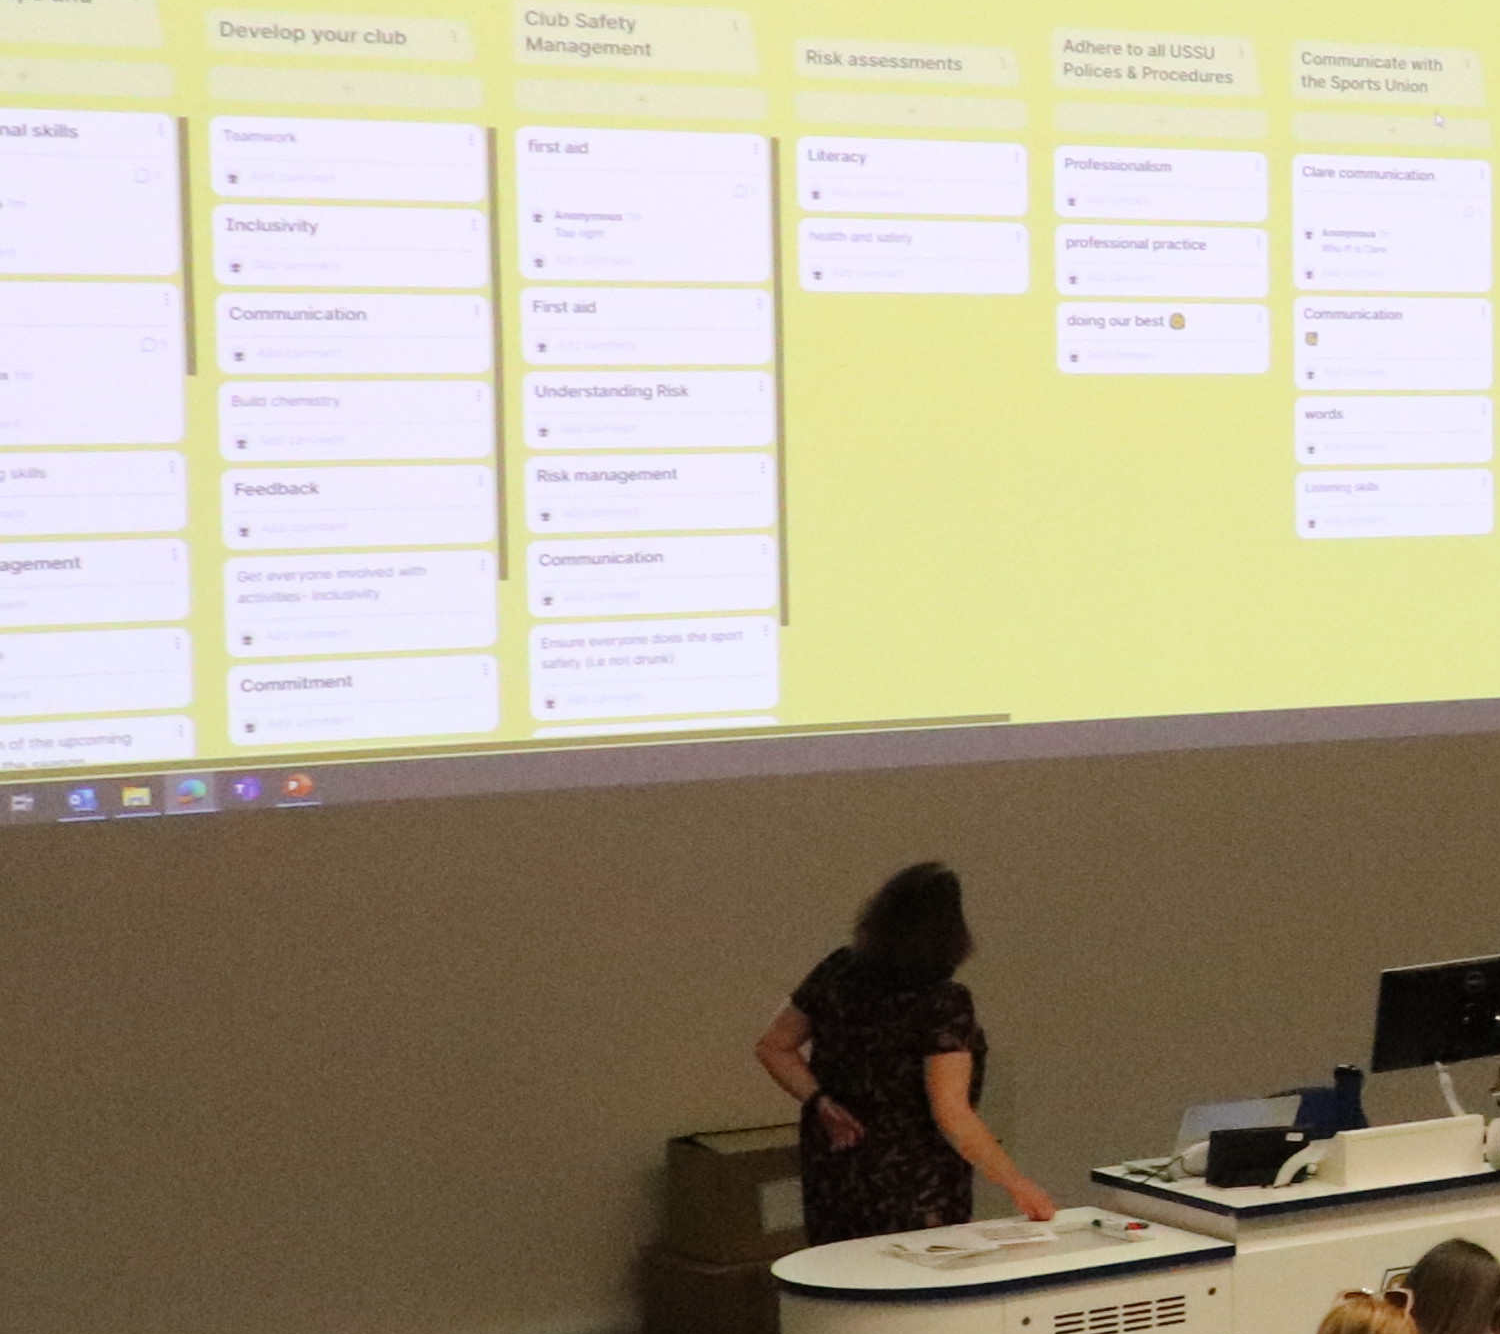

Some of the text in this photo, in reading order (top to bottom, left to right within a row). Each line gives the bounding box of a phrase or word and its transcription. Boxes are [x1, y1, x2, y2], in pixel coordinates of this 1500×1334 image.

[524, 10, 636, 34] Club Safety
[219, 20, 407, 46] Develop your club
[526, 36, 652, 58] Management
[1063, 39, 1215, 61] Adhere to all USSU
[806, 49, 962, 72] Risk assessments
[1301, 51, 1443, 72] Communicate with
[1063, 62, 1234, 85] Polices & Procedures
[1301, 75, 1428, 93] the Sports Union
[32, 124, 79, 139] skills
[224, 129, 297, 144] Teamwork
[564, 141, 589, 155] aid
[807, 148, 867, 165] Literacy
[1064, 157, 1172, 173] Professionalism
[1302, 166, 1435, 183] Clare communication
[226, 217, 318, 235] Inclusivity
[1066, 237, 1207, 251] professional practice
[228, 306, 367, 322] Communication
[533, 300, 597, 314] First aid
[1303, 308, 1403, 321] Communication
[1067, 314, 1164, 329] doing our best
[535, 384, 689, 400] Understanding Risk
[1305, 408, 1344, 420] words
[537, 468, 678, 485] Risk management
[234, 482, 319, 496] Feedback
[538, 551, 664, 567] Communication
[240, 675, 353, 693] Commitment
